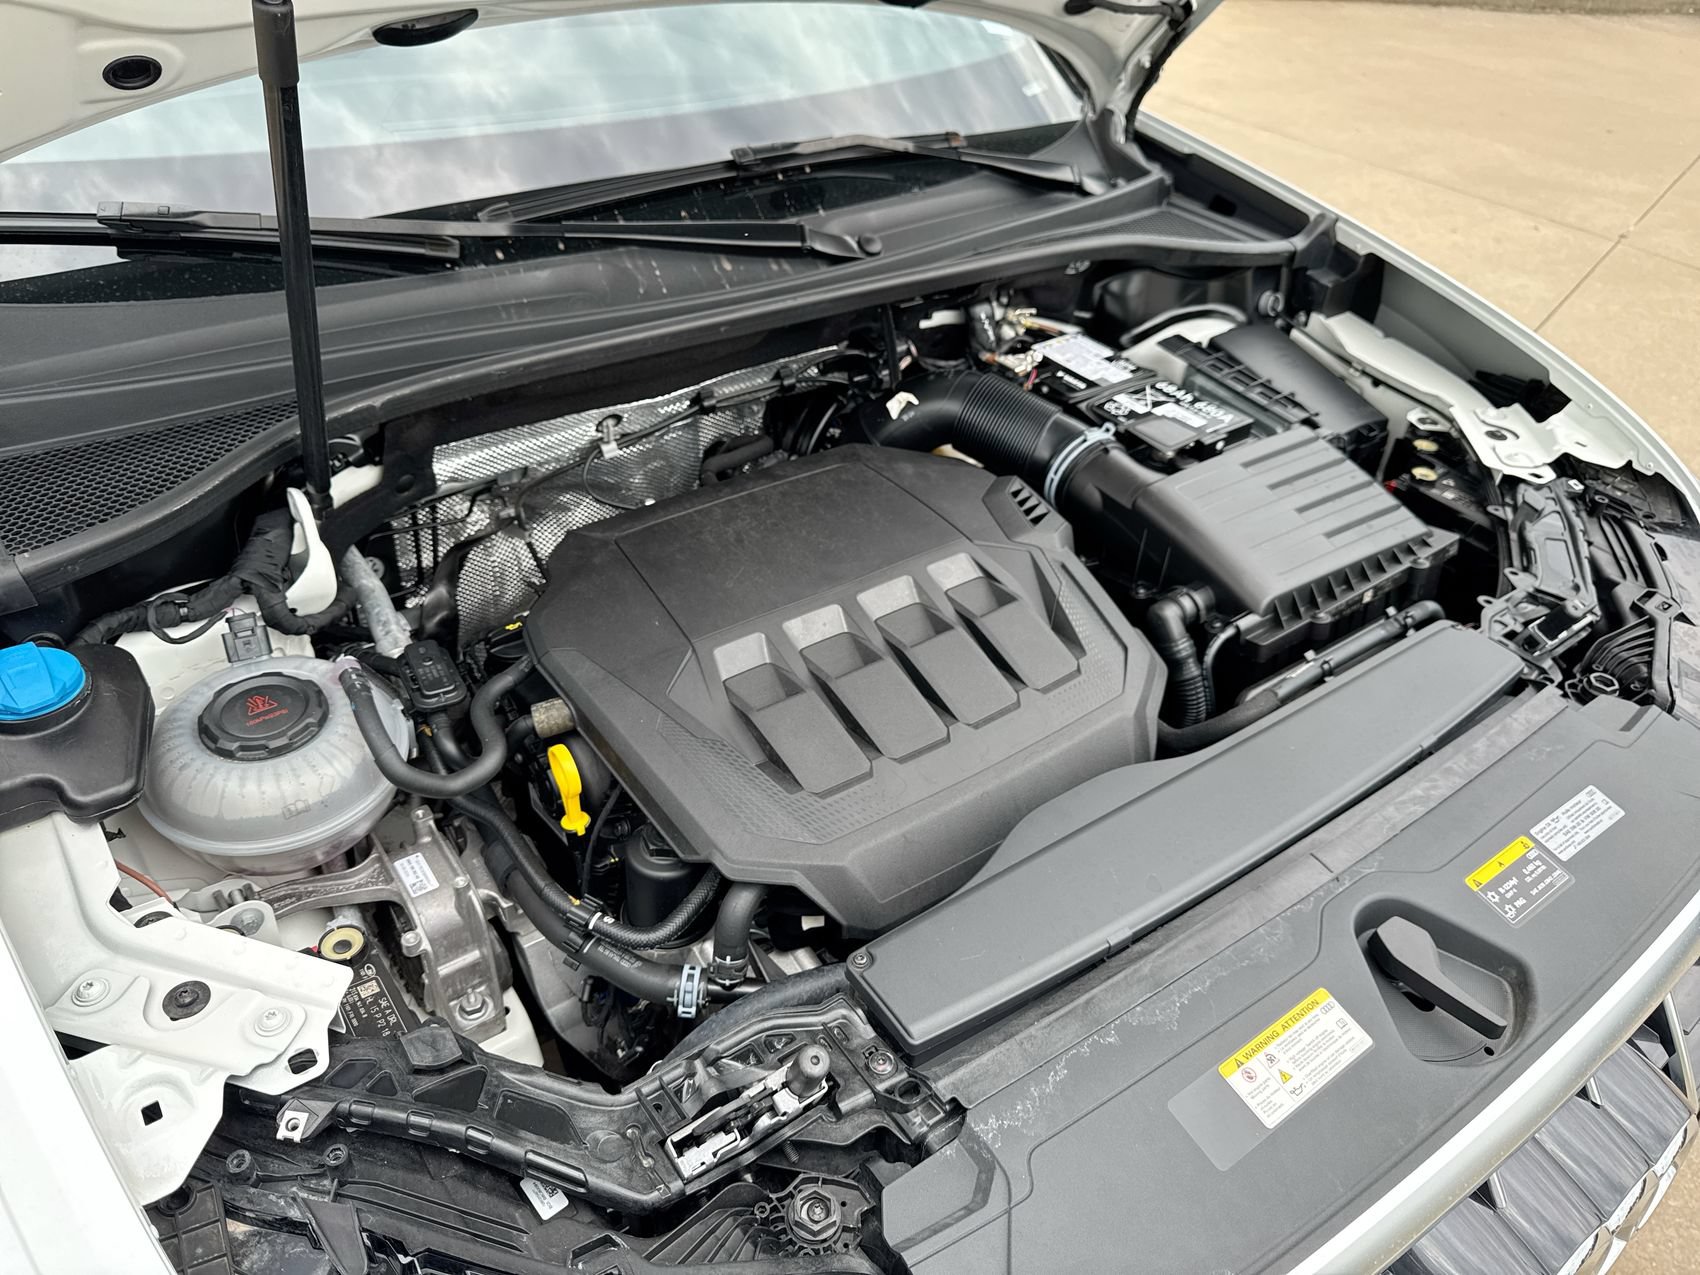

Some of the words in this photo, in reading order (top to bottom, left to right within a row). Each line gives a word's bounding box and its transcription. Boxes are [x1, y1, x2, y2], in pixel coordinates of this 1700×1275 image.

[378, 997, 390, 1009] SAE
[386, 1013, 397, 1026] DRL
[1242, 1030, 1280, 1061] WARNING
[1280, 998, 1320, 1032] ATTENTION
